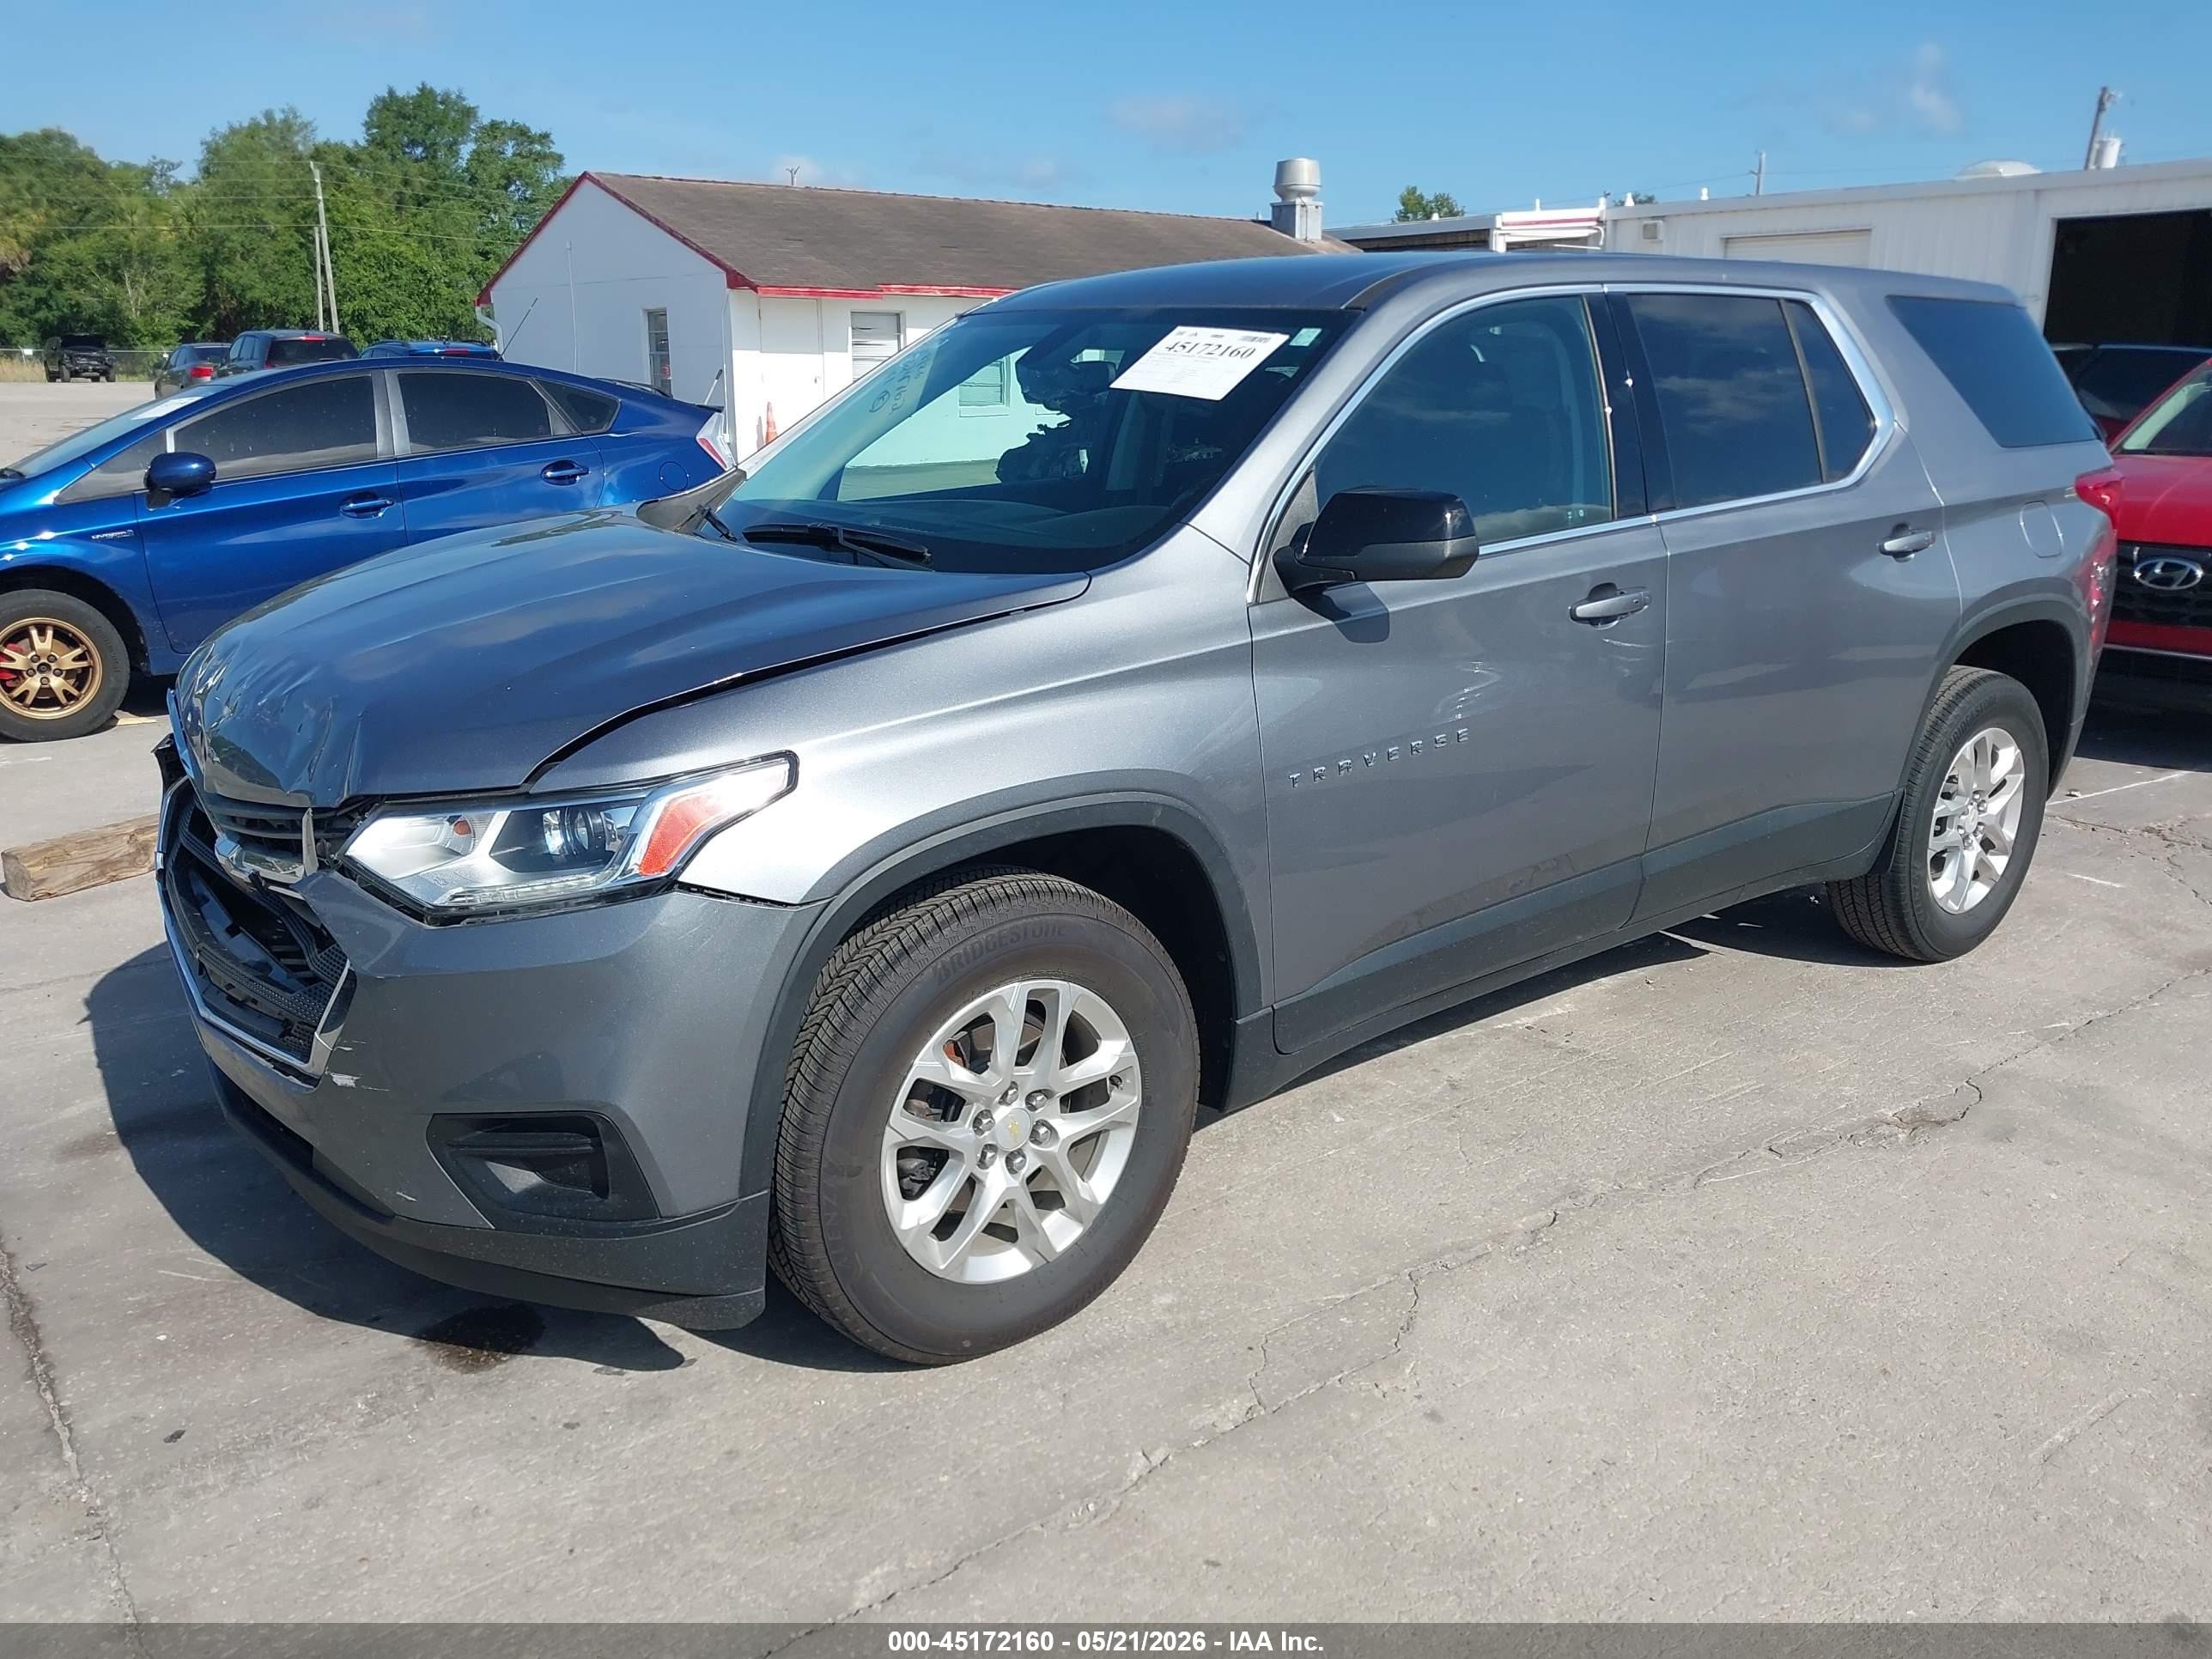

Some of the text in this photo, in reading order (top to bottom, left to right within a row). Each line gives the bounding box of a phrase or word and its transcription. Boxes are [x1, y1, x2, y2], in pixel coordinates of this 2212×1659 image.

[1165, 340, 1257, 360] 45172160
[1288, 727, 1470, 789] TRAVERSE
[933, 919, 1066, 986] BRIDGESTONE
